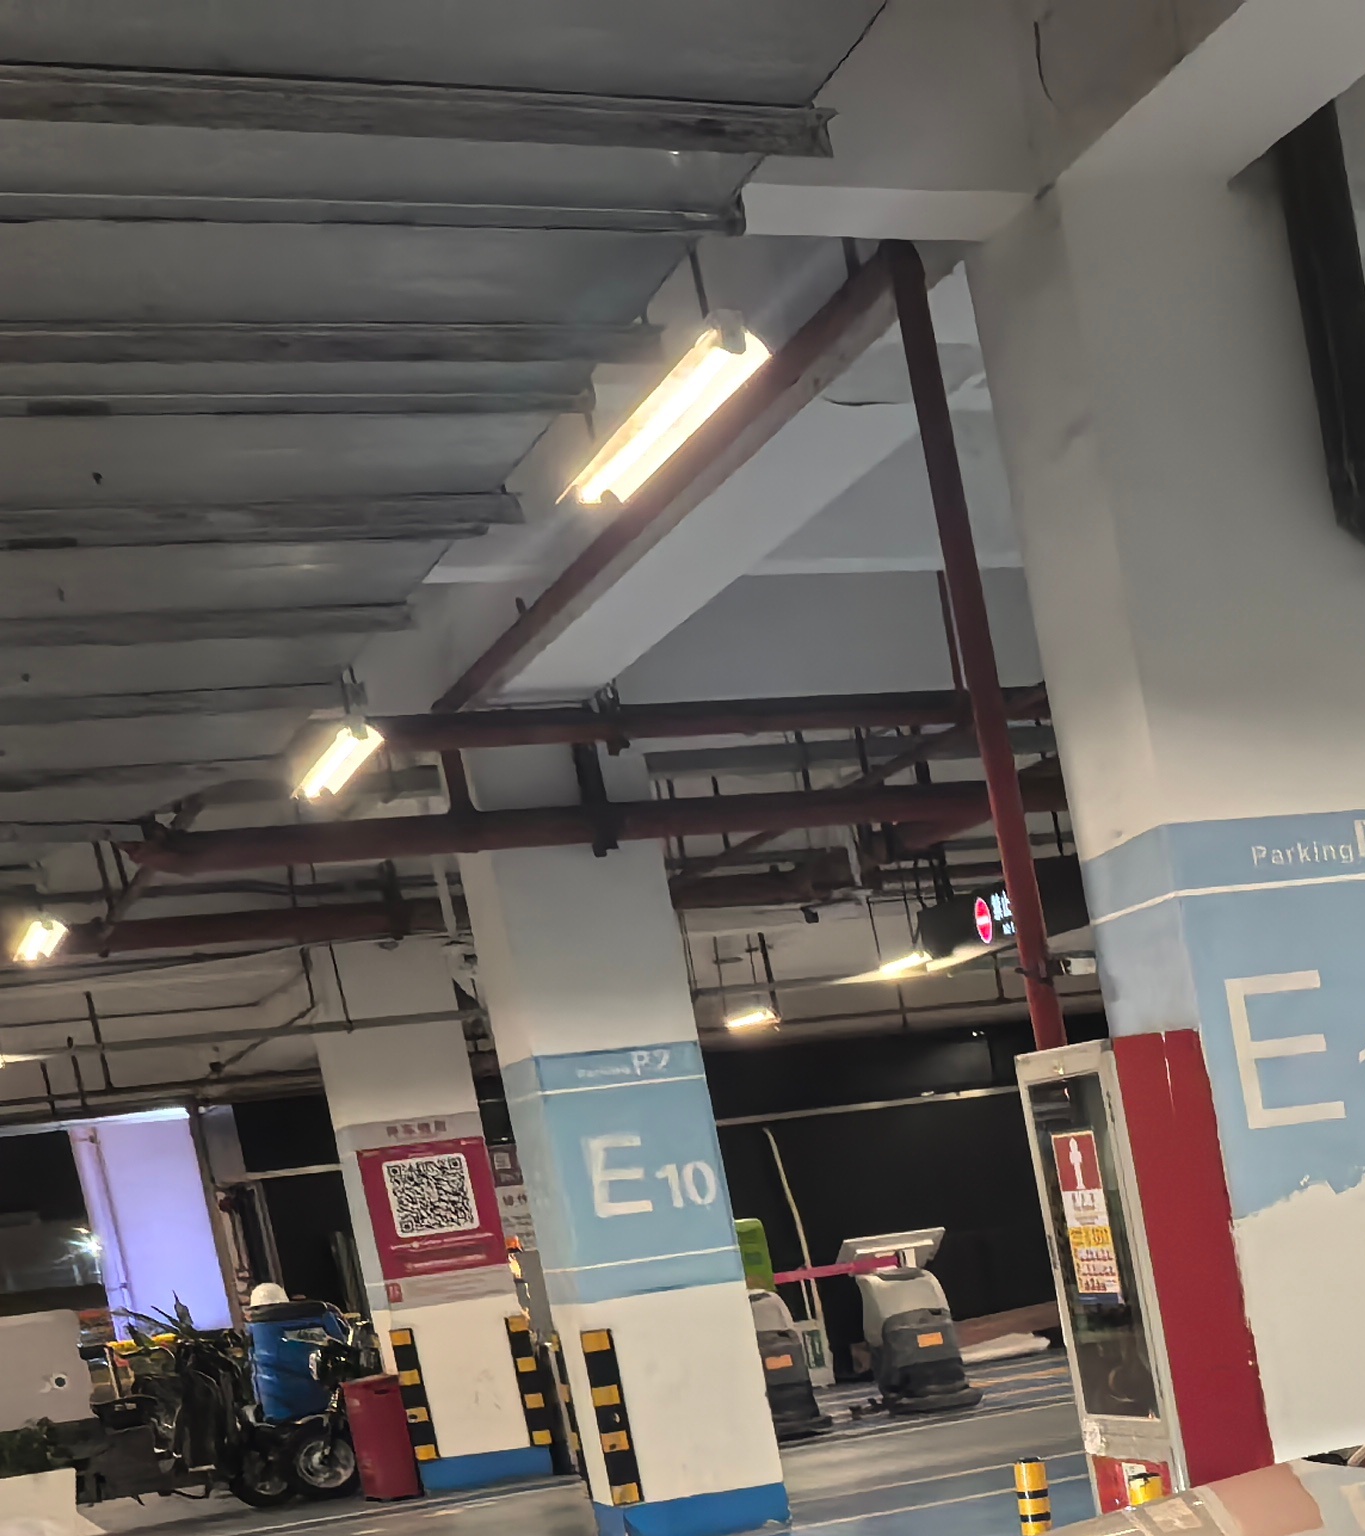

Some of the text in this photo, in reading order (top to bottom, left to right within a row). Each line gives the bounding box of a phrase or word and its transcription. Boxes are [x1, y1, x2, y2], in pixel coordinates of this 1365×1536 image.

[1251, 839, 1355, 867] Parking
[1224, 969, 1347, 1130] E
[580, 1131, 717, 1219] E 10
